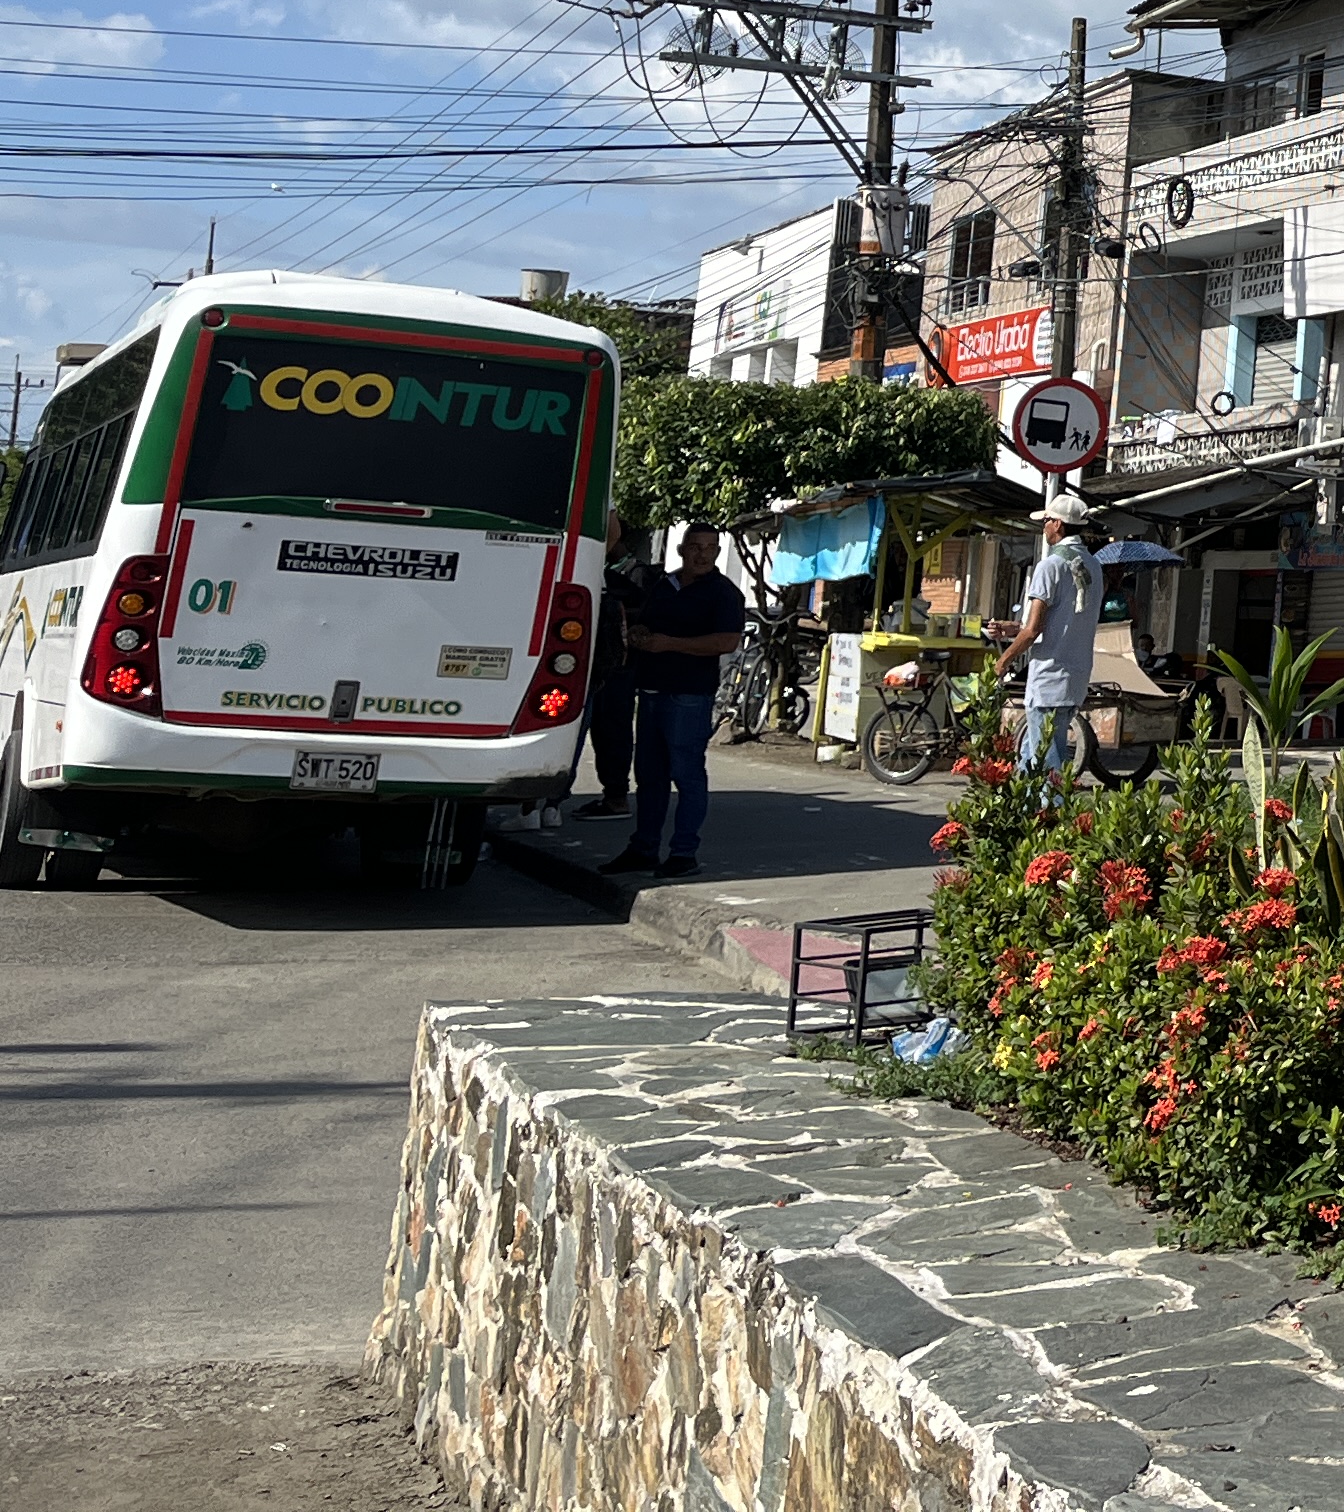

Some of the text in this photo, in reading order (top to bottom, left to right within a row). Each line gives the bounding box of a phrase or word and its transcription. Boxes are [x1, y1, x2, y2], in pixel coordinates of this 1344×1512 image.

[957, 326, 993, 362] Electro
[994, 314, 1031, 355] Urabá
[260, 365, 571, 436] COOINTUR
[288, 541, 454, 567] CHEVROLET
[285, 558, 452, 580] TECNOLOGIA ISUZU
[188, 578, 237, 615] 01
[221, 690, 462, 716] SERVICIO PUBLICO
[297, 757, 376, 781] SWT 520
